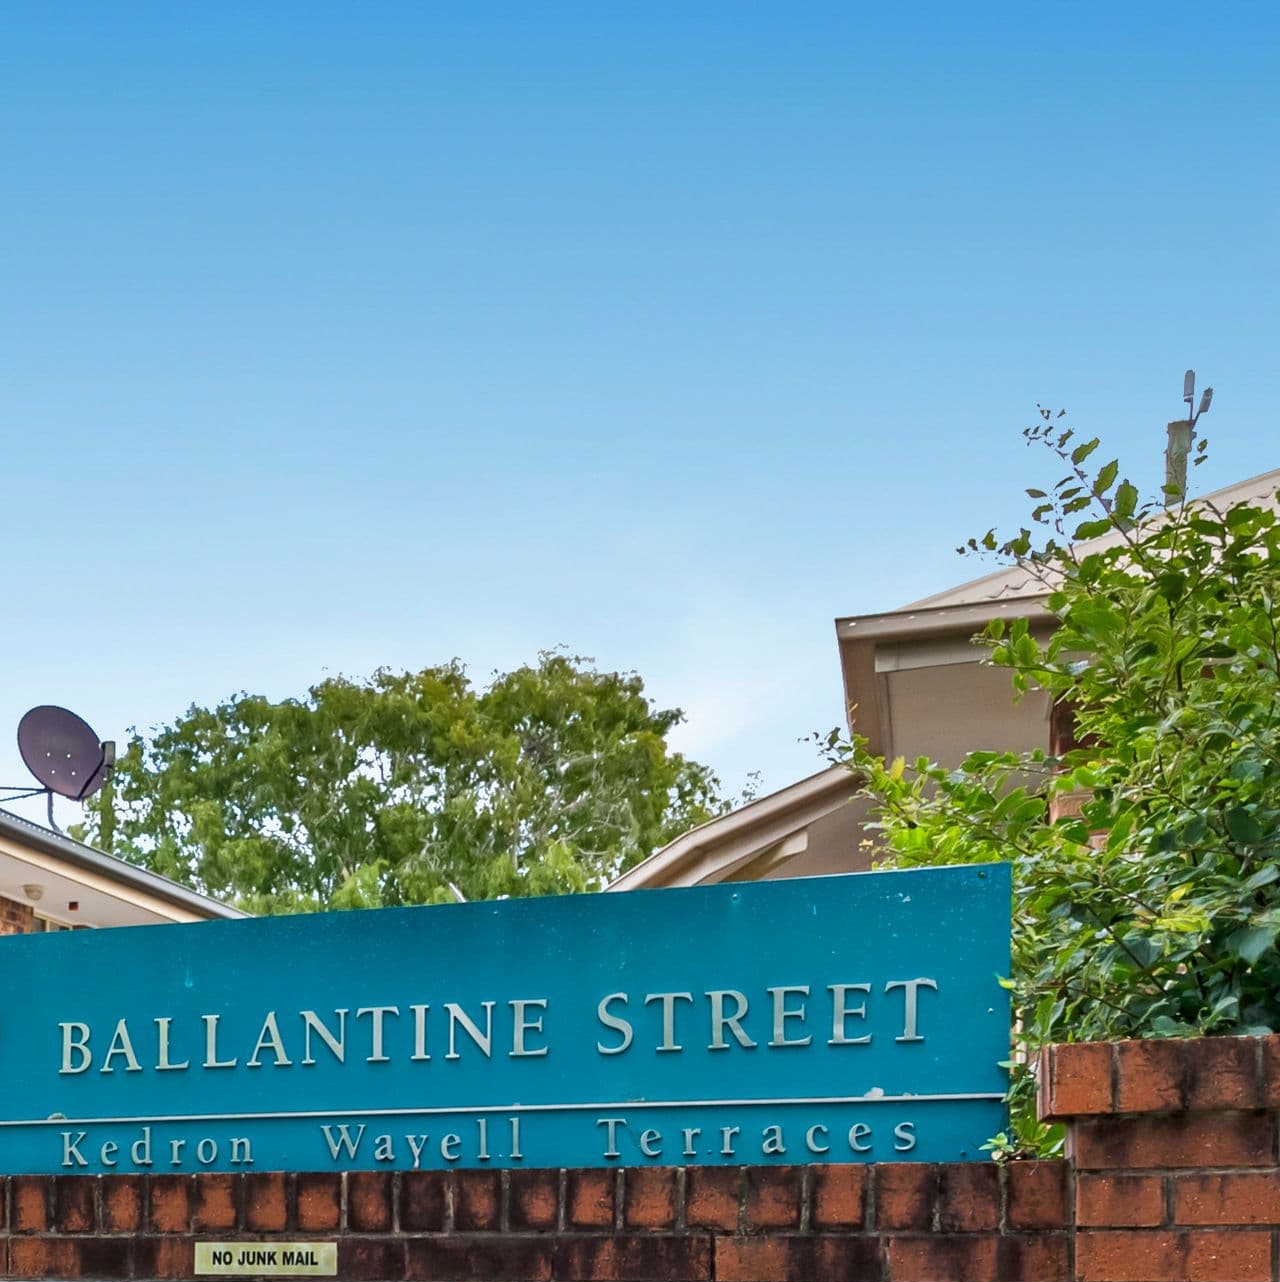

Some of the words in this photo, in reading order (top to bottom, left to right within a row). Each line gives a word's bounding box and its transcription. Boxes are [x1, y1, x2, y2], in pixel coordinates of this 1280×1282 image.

[57, 998, 550, 1076] BALLANTINE
[596, 977, 938, 1055] STREET
[59, 1126, 254, 1167] Kedron
[595, 1118, 918, 1161] Terraces
[211, 1250, 233, 1266] NO
[237, 1250, 278, 1267] JUNK
[281, 1250, 319, 1267] MAIL
